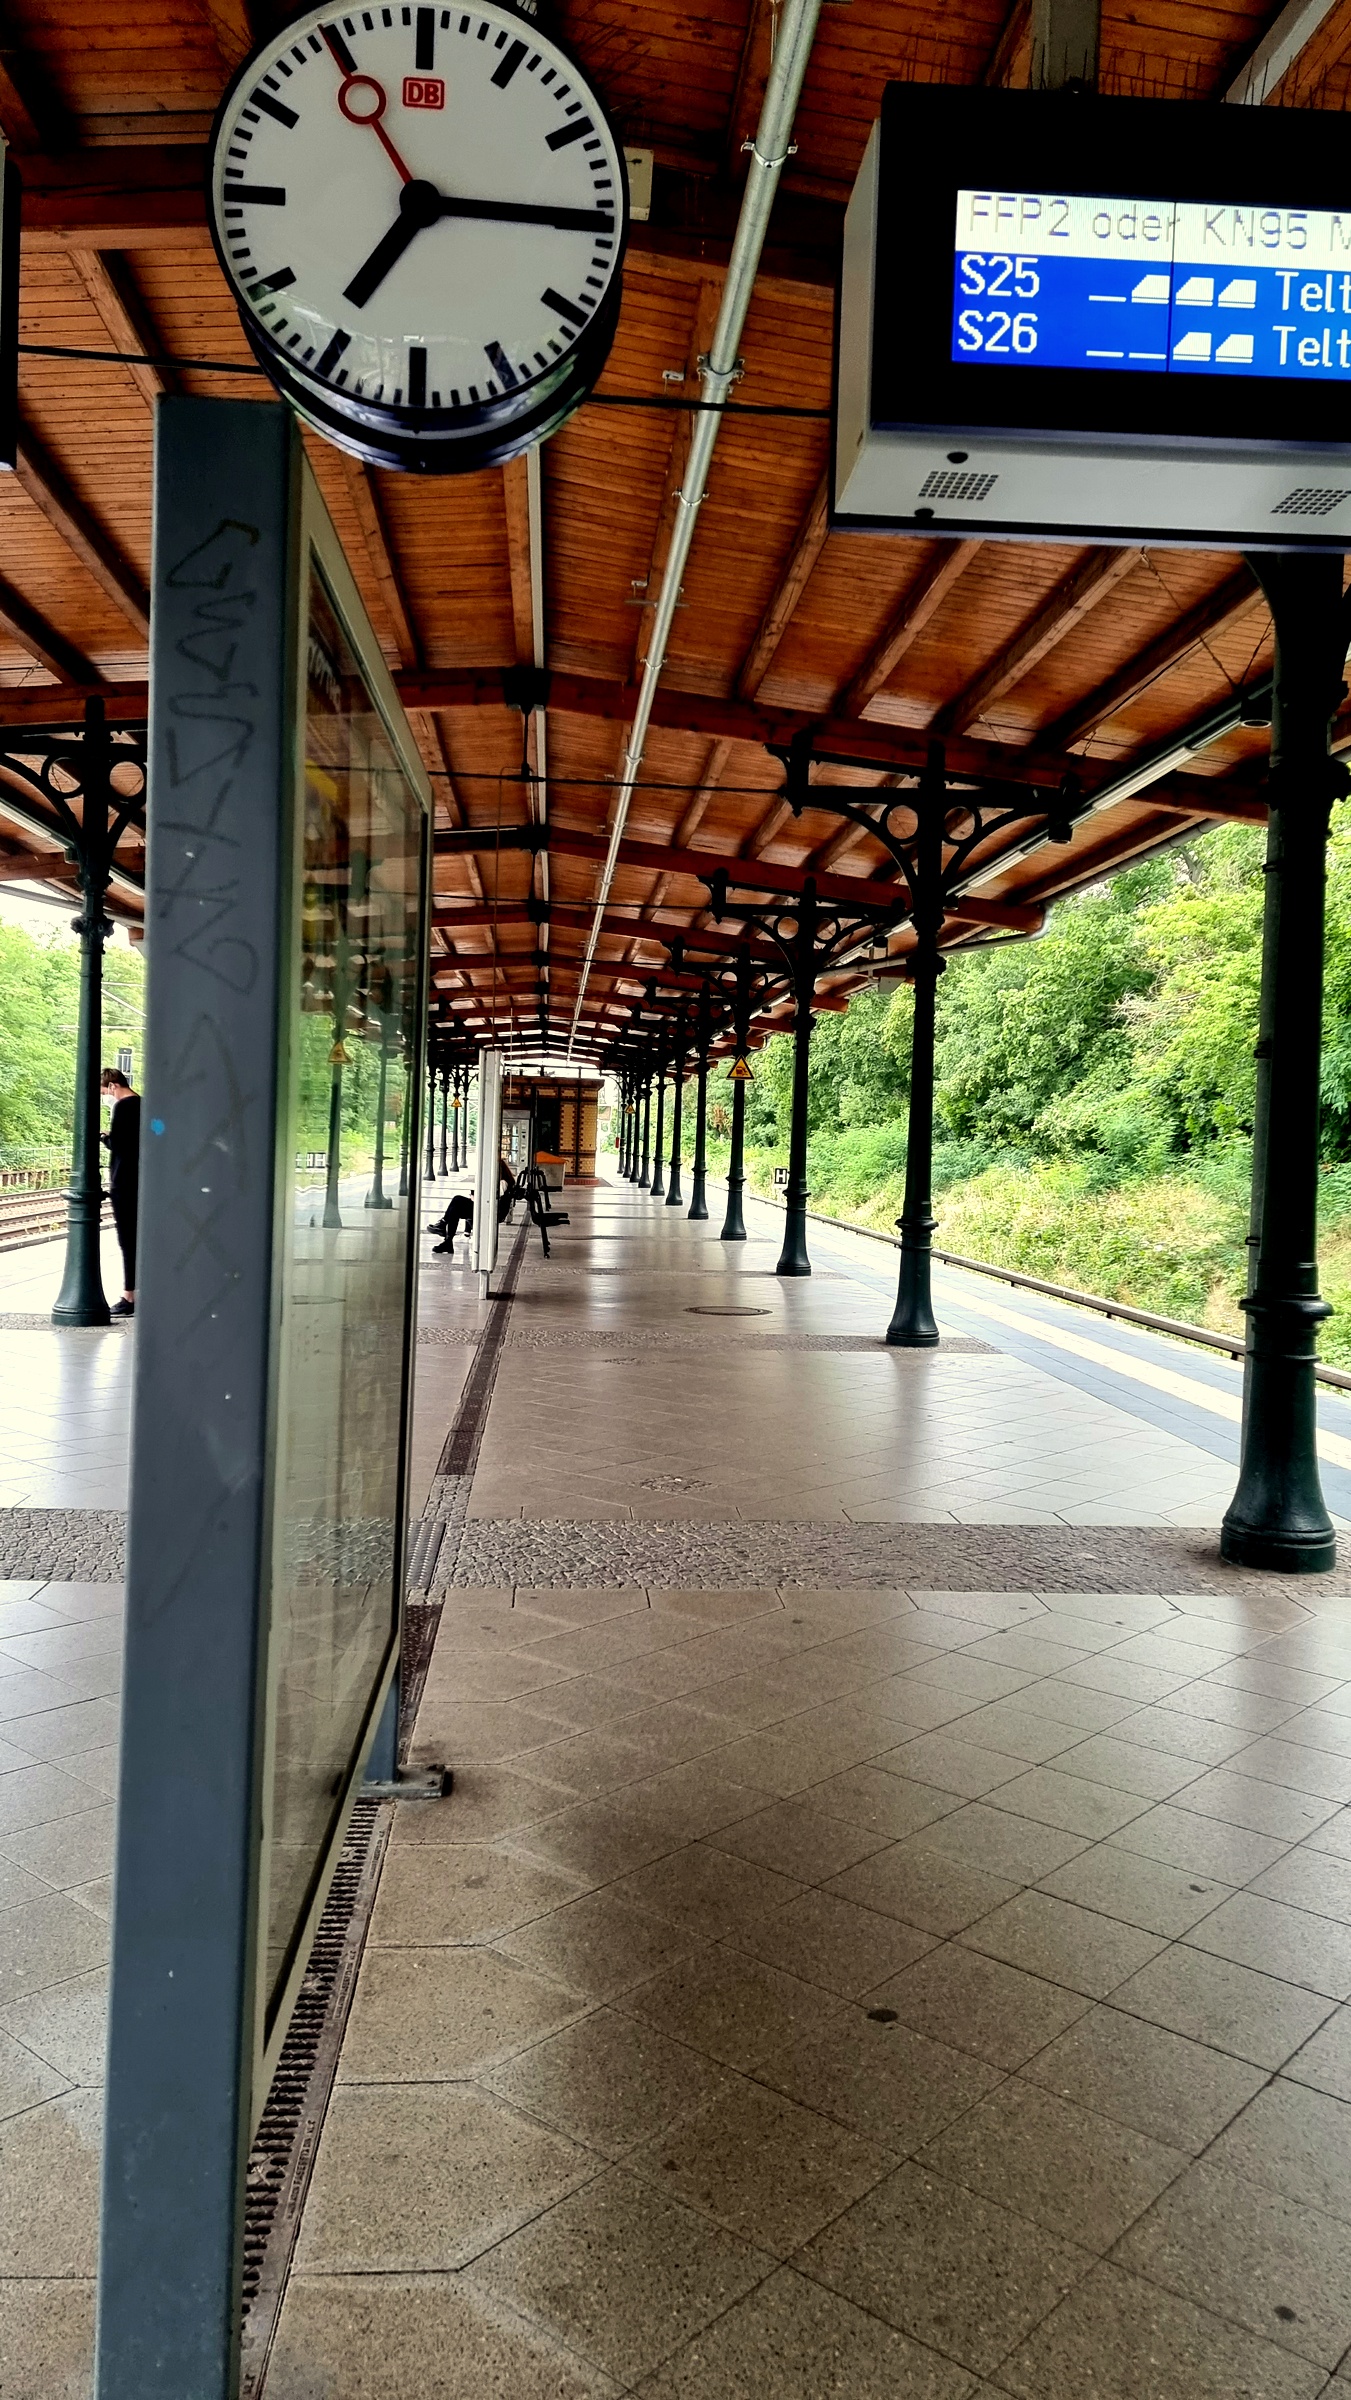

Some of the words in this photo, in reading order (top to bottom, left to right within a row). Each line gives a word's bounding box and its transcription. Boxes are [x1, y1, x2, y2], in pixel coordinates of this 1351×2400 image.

[407, 81, 441, 105] DB
[969, 194, 1070, 237] FFP2
[1091, 203, 1181, 243] oder
[1202, 207, 1308, 250] KN95
[959, 254, 1040, 298] S25
[957, 310, 1038, 354] S26
[775, 1169, 787, 1183] H
